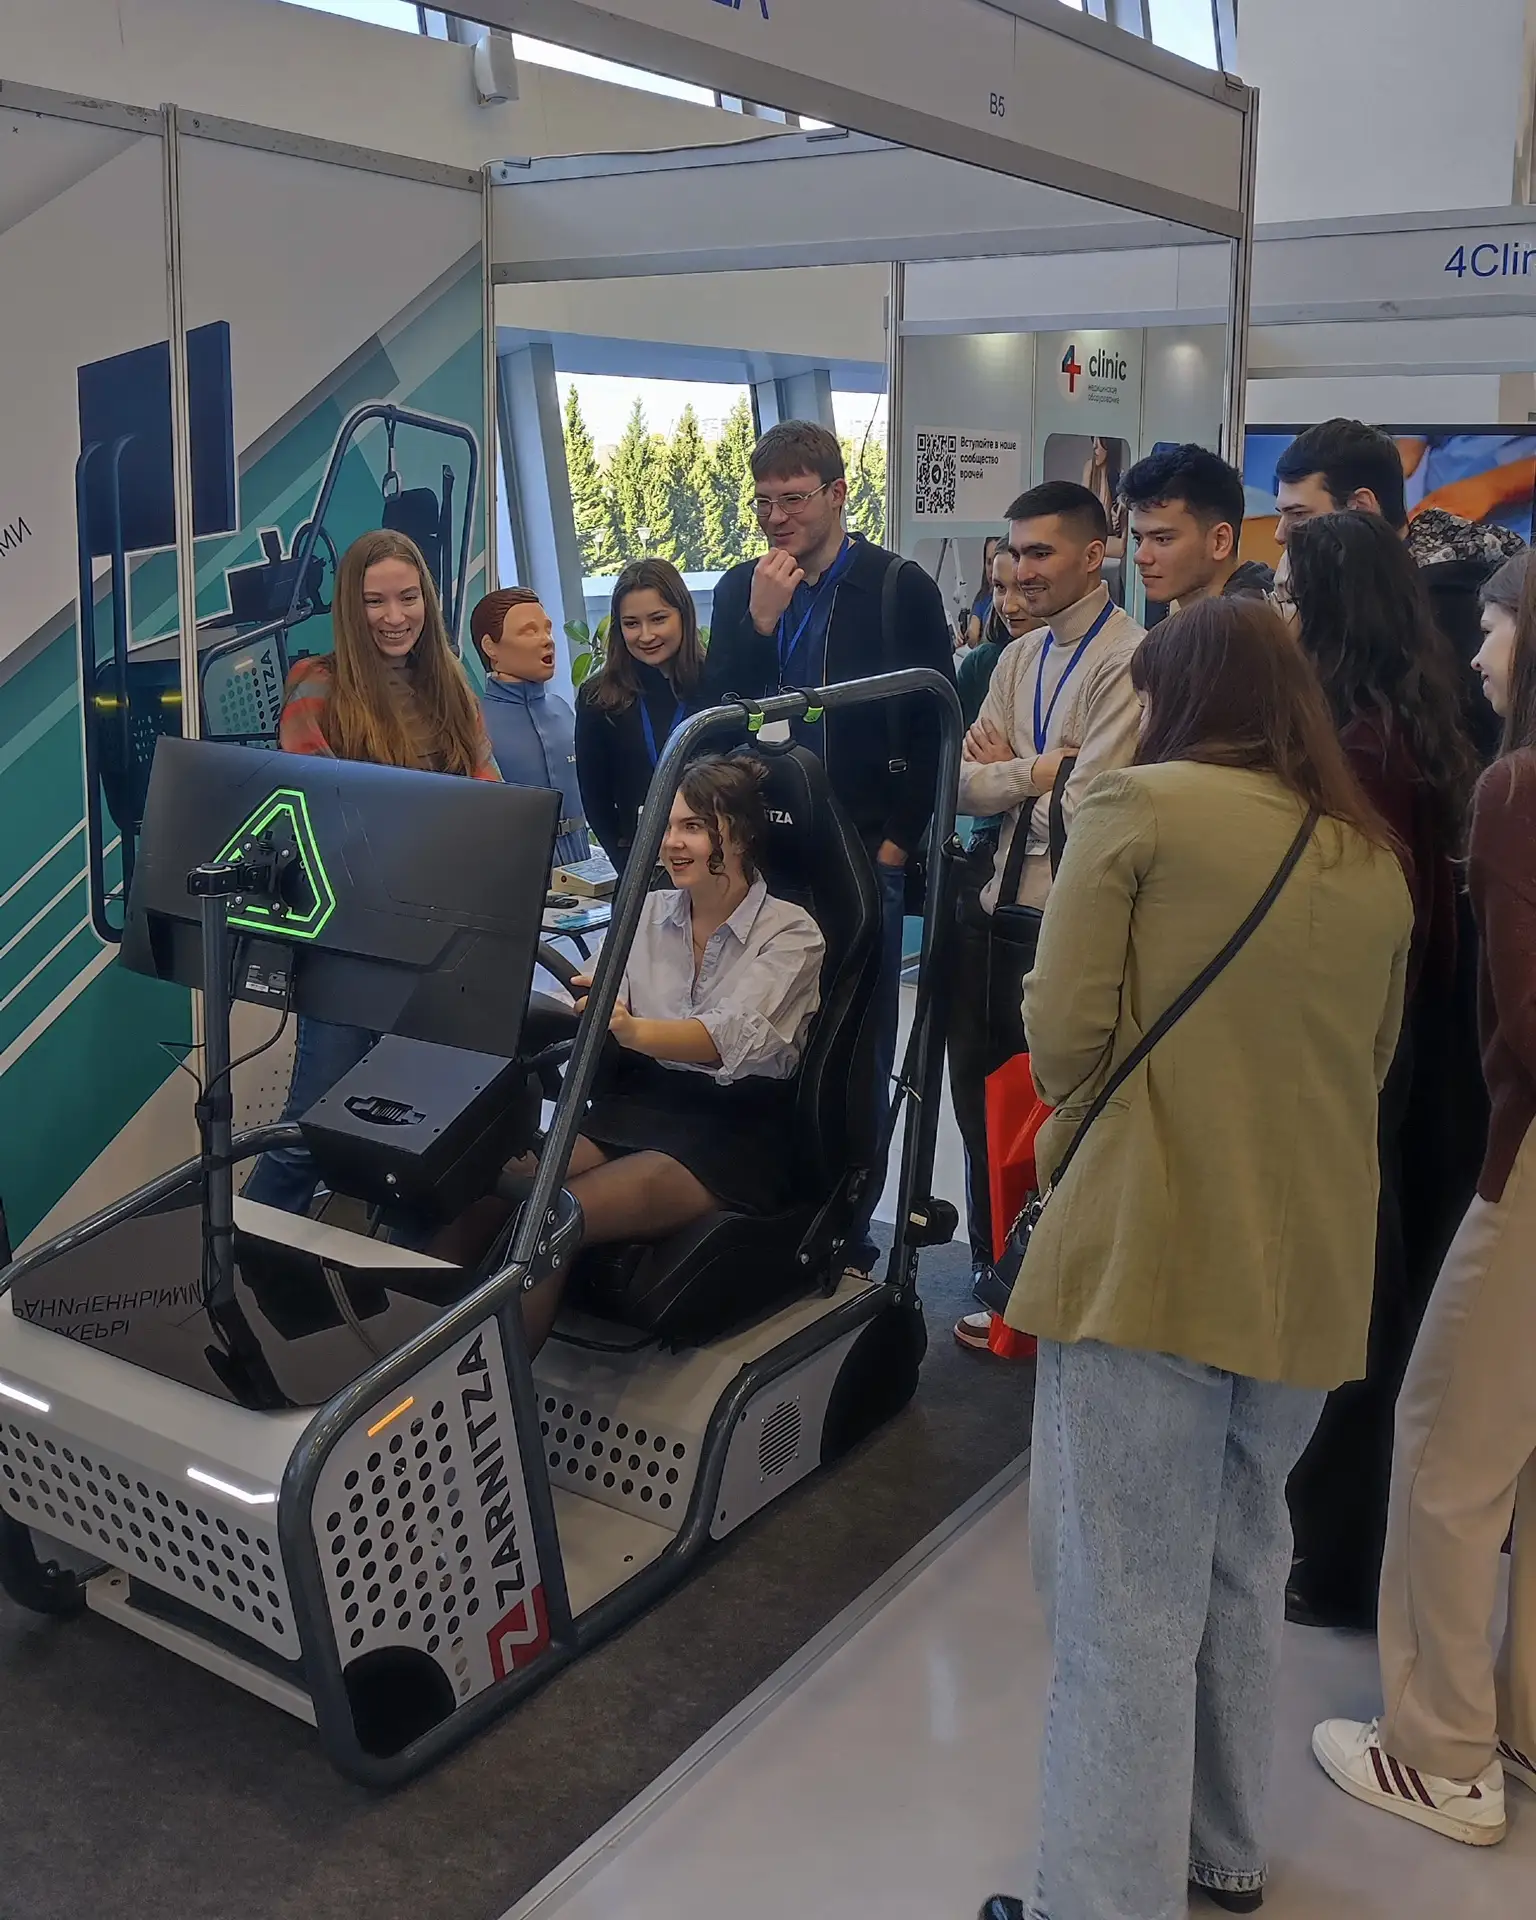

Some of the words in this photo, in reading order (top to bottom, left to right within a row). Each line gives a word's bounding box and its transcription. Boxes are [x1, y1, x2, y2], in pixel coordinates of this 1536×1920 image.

[990, 92, 1005, 117] B5
[1089, 348, 1127, 381] clinic
[960, 436, 994, 451] Вступайте
[994, 440, 999, 450] в
[1000, 441, 1017, 450] наше
[960, 453, 999, 465] сообщество
[960, 468, 984, 481] врачей
[457, 1332, 526, 1610] ZARNITZA
